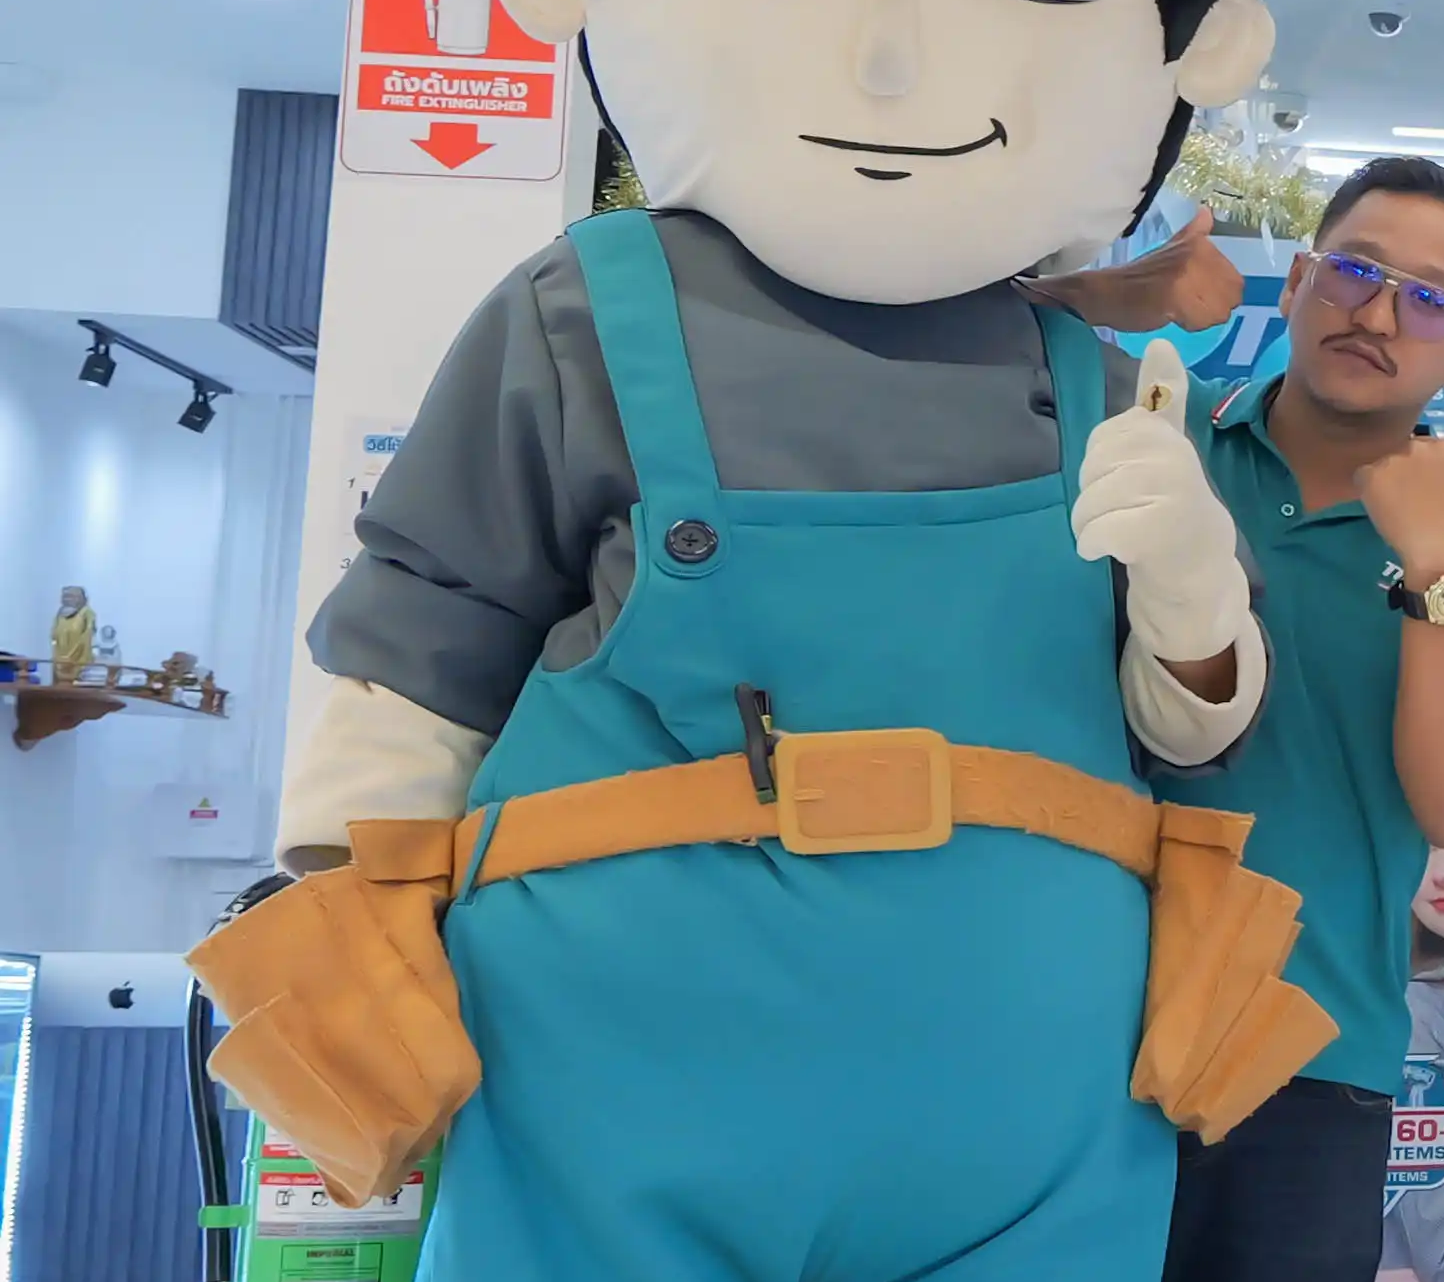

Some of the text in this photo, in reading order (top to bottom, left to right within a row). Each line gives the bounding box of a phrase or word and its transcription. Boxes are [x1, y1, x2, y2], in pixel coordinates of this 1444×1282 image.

[383, 70, 528, 99] ถังดับเพลิง
[381, 95, 528, 112] FIRE EXTINGUISHER
[1387, 1171, 1428, 1182] ITEMS
